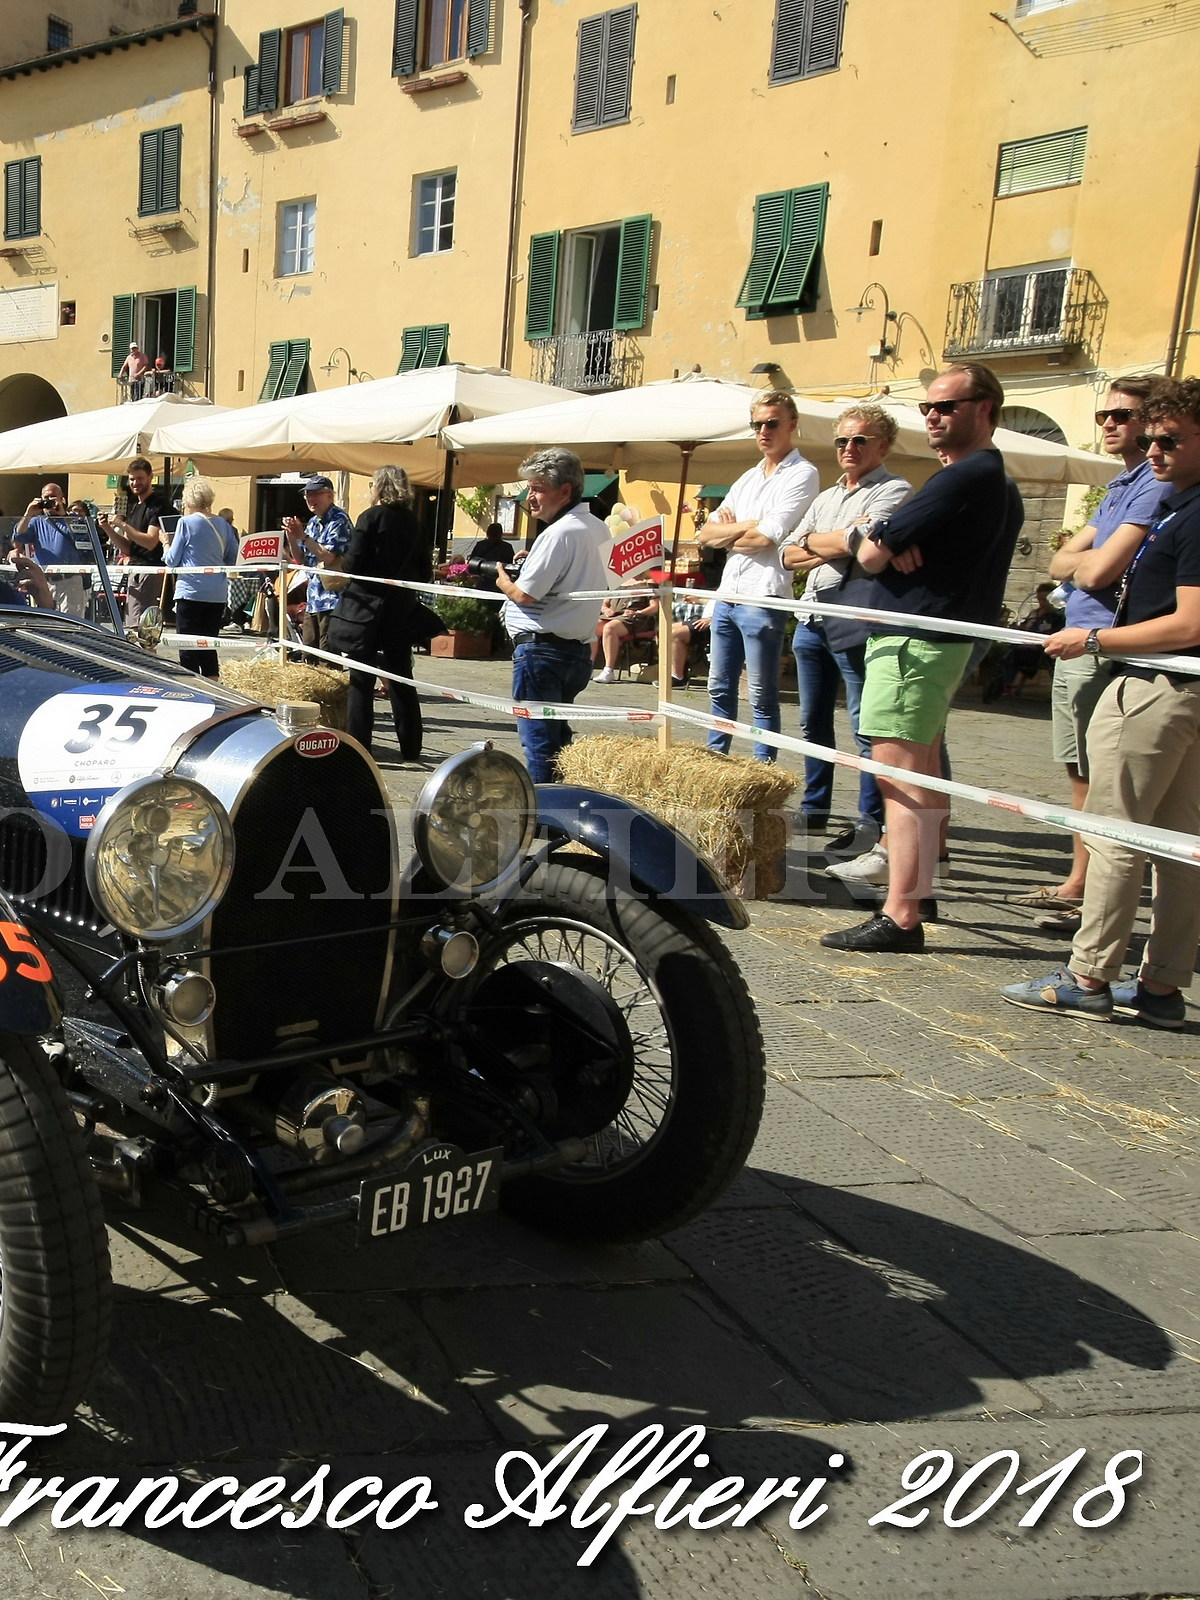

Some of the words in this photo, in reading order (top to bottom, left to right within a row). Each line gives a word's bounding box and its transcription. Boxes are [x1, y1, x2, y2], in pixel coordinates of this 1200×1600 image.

[250, 539, 276, 548] 1000
[620, 530, 657, 555] 1000
[246, 549, 276, 557] MIGLIA
[621, 543, 663, 572] MIGLIA
[63, 703, 159, 754] 35
[299, 738, 336, 751] BUGATTI
[423, 1149, 452, 1165] Lux
[371, 1181, 411, 1236] EB
[422, 1160, 492, 1223] 1927
